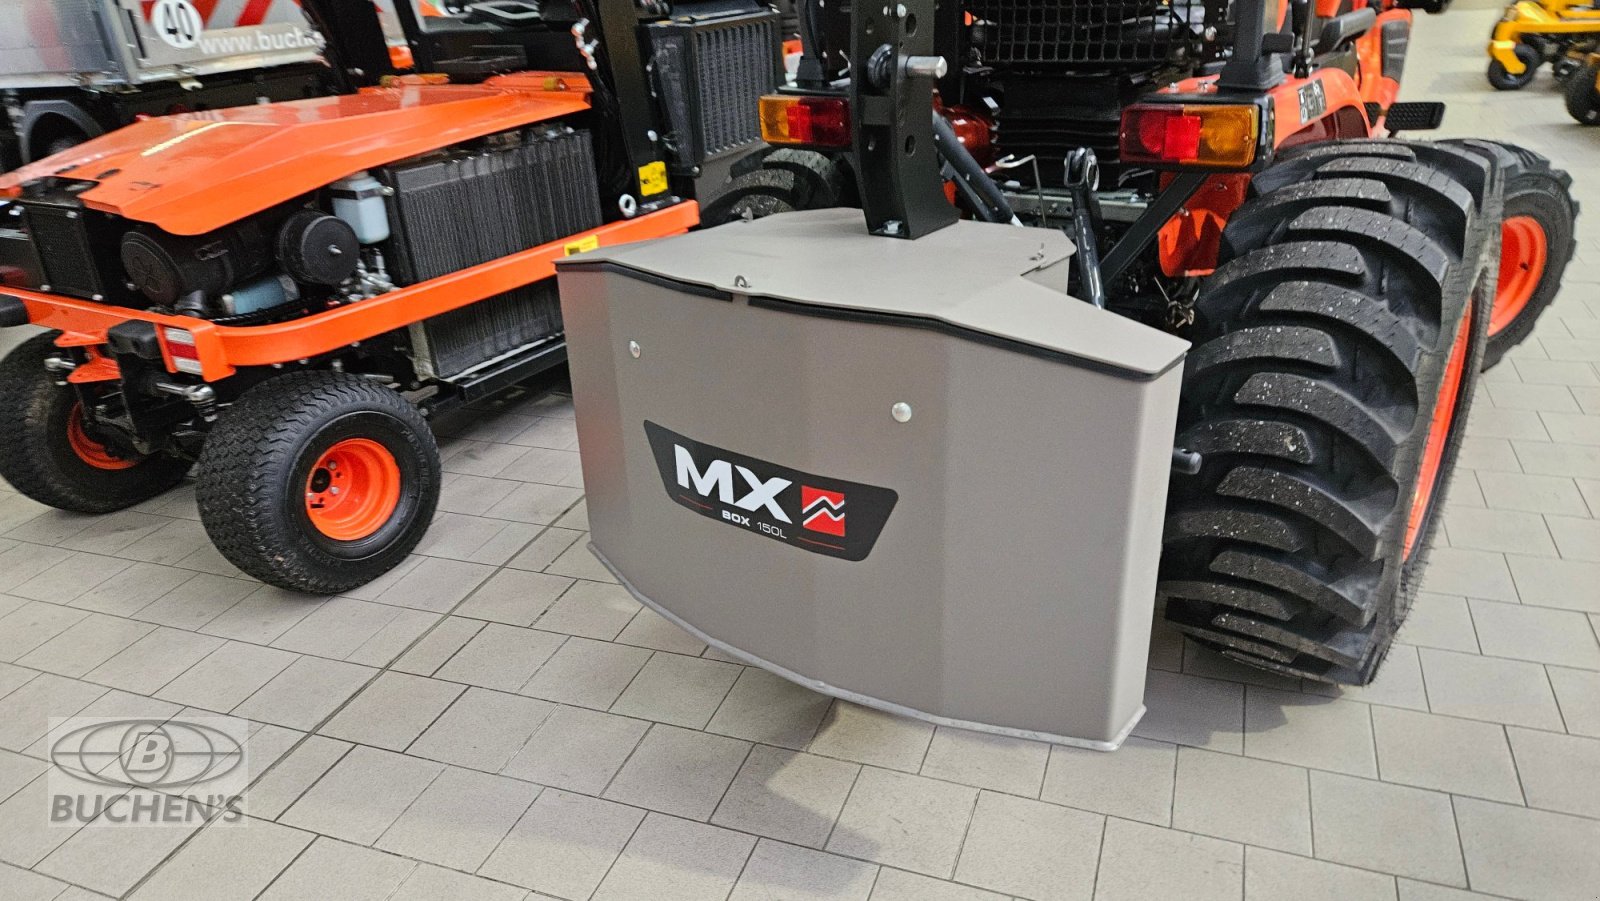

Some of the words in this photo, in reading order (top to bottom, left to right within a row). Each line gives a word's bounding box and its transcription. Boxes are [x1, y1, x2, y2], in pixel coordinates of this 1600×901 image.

[164, 2, 196, 44] 40
[674, 443, 793, 525] MX
[721, 510, 751, 527] BOX
[756, 521, 788, 539] 150L
